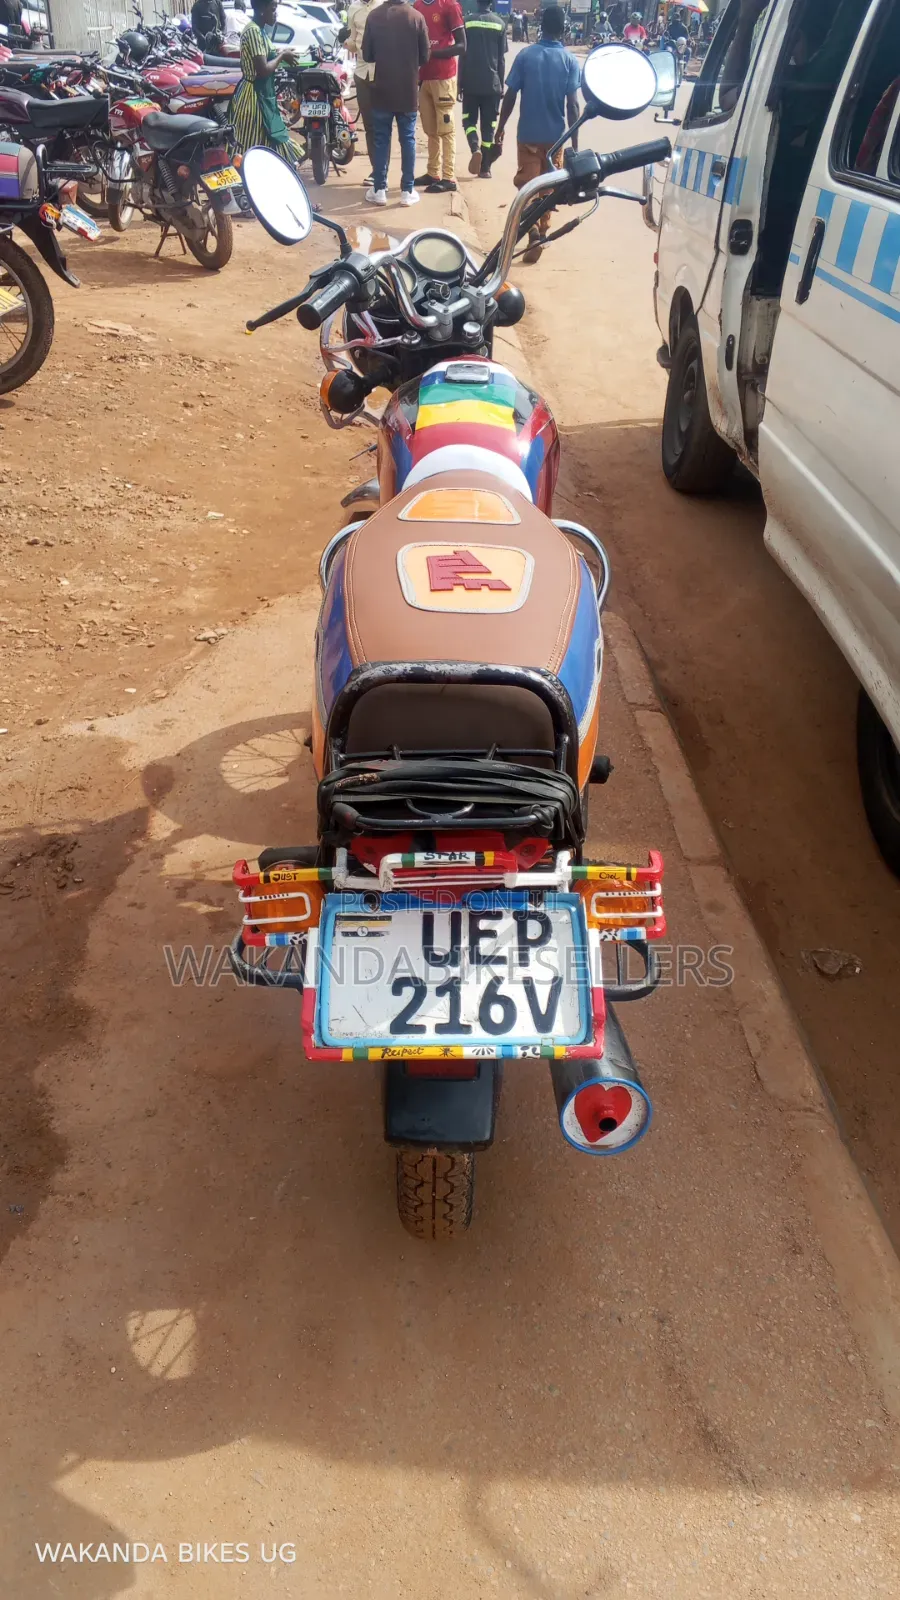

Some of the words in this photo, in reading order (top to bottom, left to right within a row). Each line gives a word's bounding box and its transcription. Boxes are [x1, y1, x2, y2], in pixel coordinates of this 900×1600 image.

[114, 108, 124, 116] TVS
[424, 852, 470, 861] STAR
[272, 872, 298, 882] JUST
[421, 910, 553, 967] UEP
[389, 975, 564, 1036] 216V
